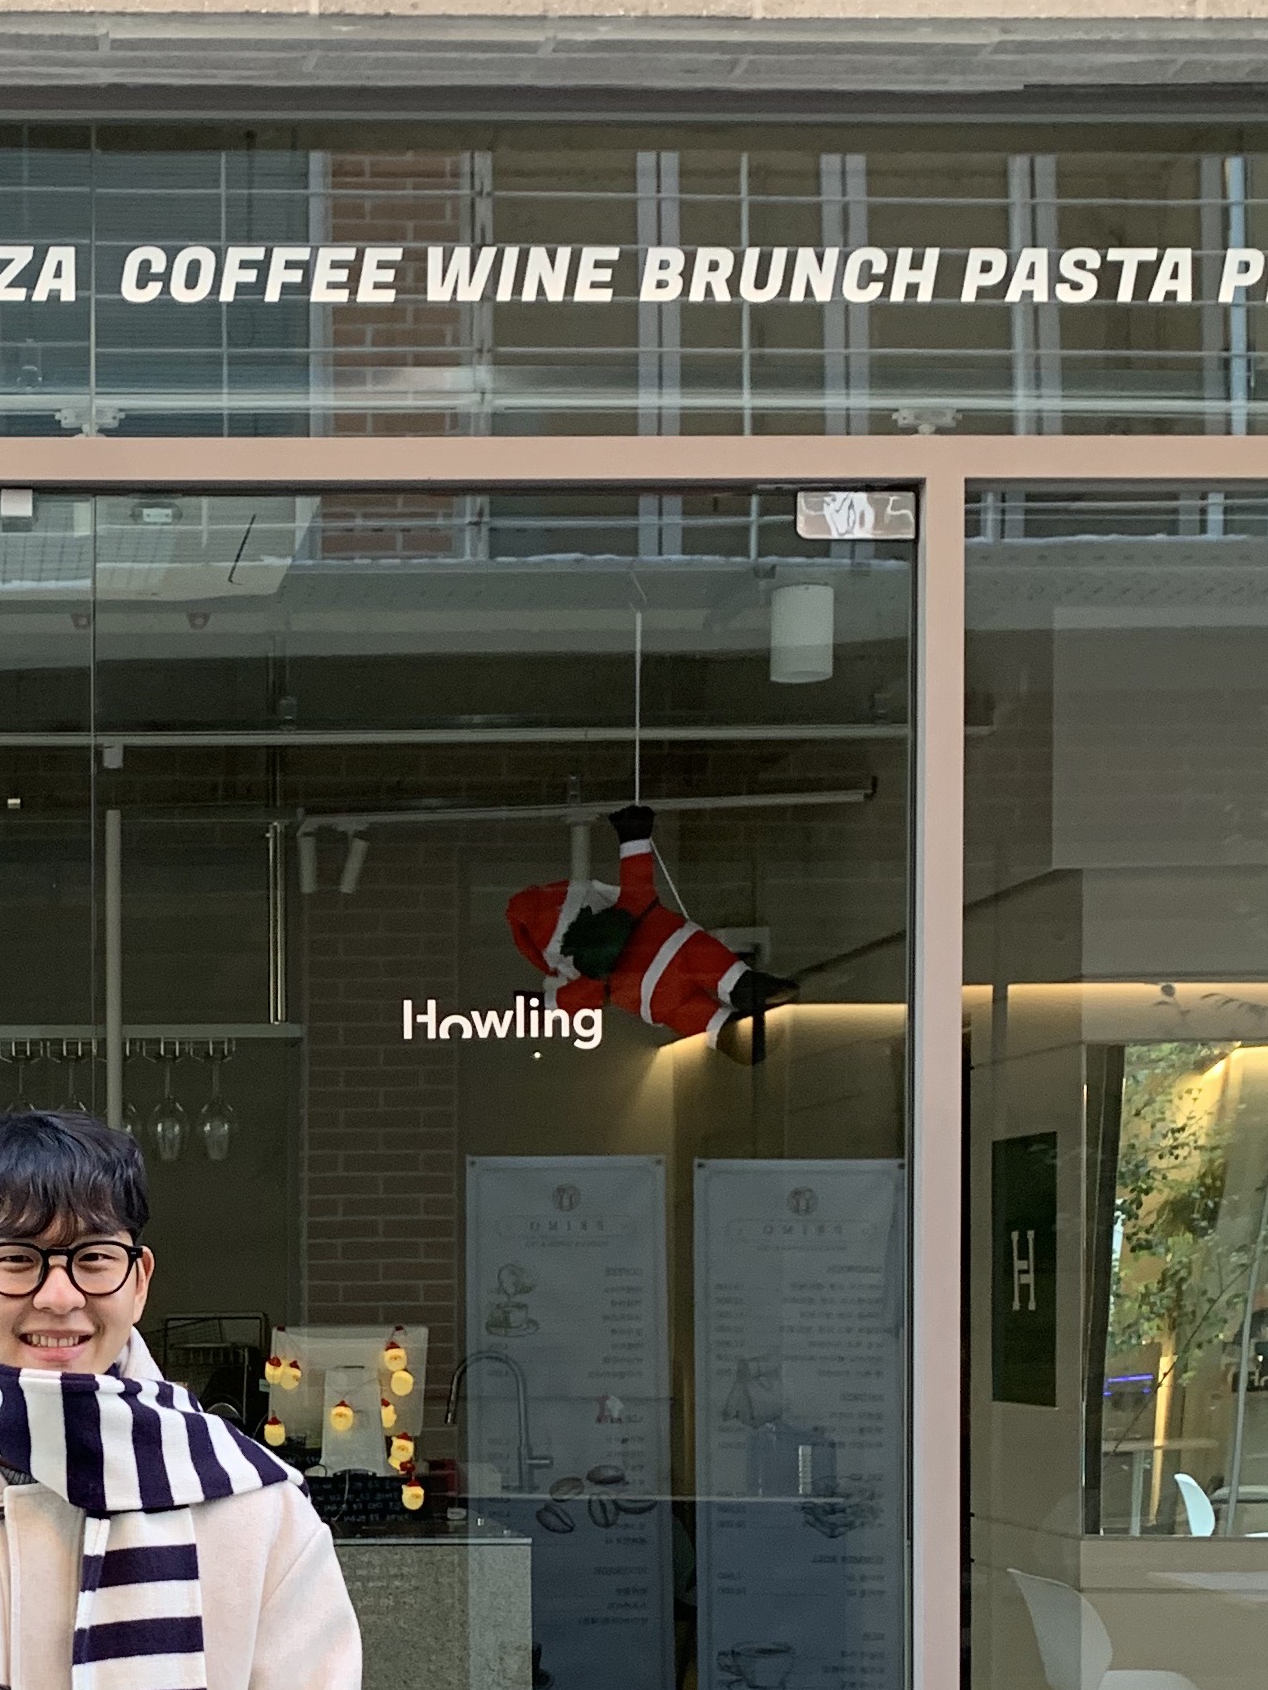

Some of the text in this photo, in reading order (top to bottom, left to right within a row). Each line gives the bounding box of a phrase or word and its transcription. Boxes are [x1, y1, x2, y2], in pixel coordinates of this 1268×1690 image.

[121, 246, 403, 303] COFFEE
[425, 246, 620, 303] WINE
[639, 246, 940, 303] BRUNCH
[960, 247, 1192, 303] PASTA
[1217, 248, 1268, 304] P
[402, 995, 604, 1059] Howling
